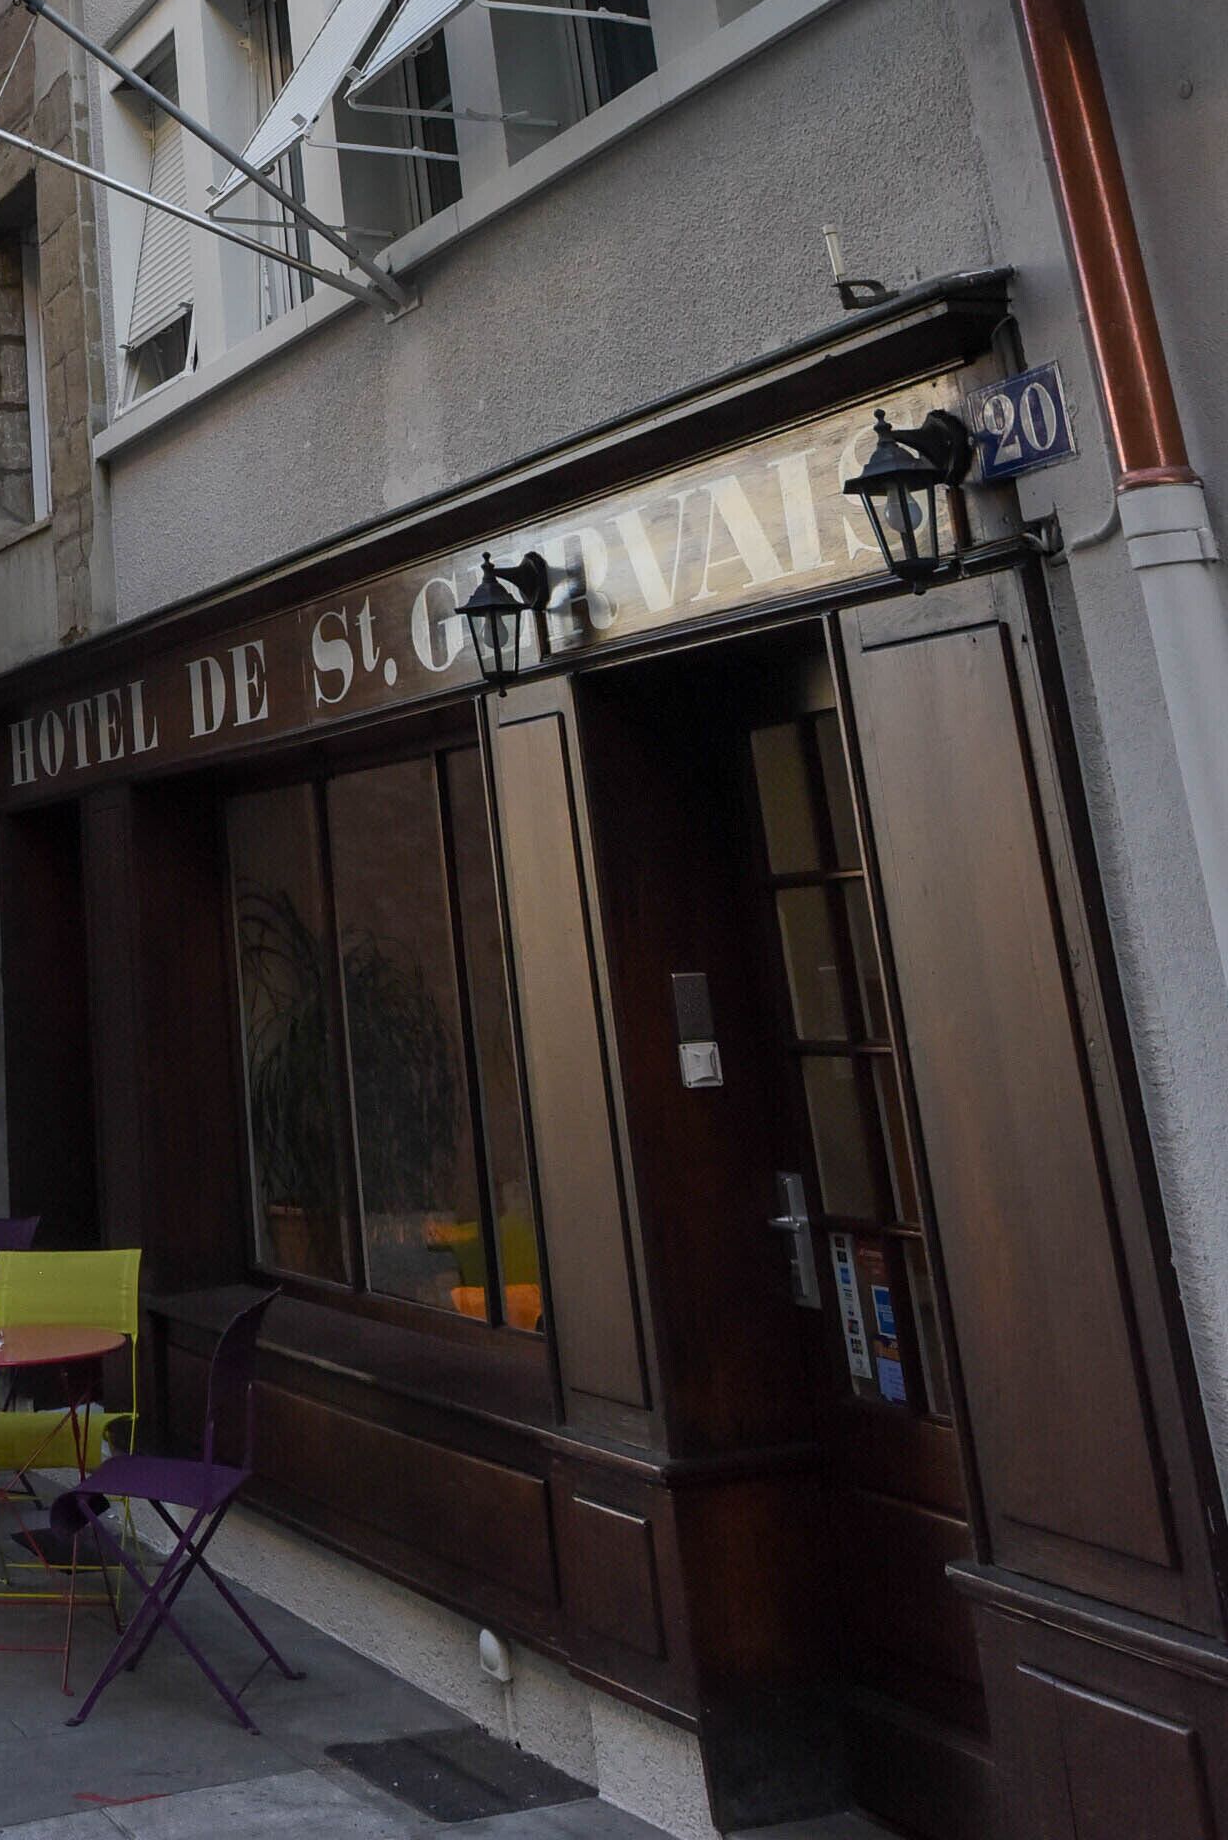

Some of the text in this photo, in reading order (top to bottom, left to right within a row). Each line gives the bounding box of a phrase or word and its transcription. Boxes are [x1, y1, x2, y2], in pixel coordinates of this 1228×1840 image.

[981, 381, 1058, 465] 20
[7, 678, 159, 788] HOTEL
[184, 639, 269, 739] DE
[311, 594, 398, 709] St.
